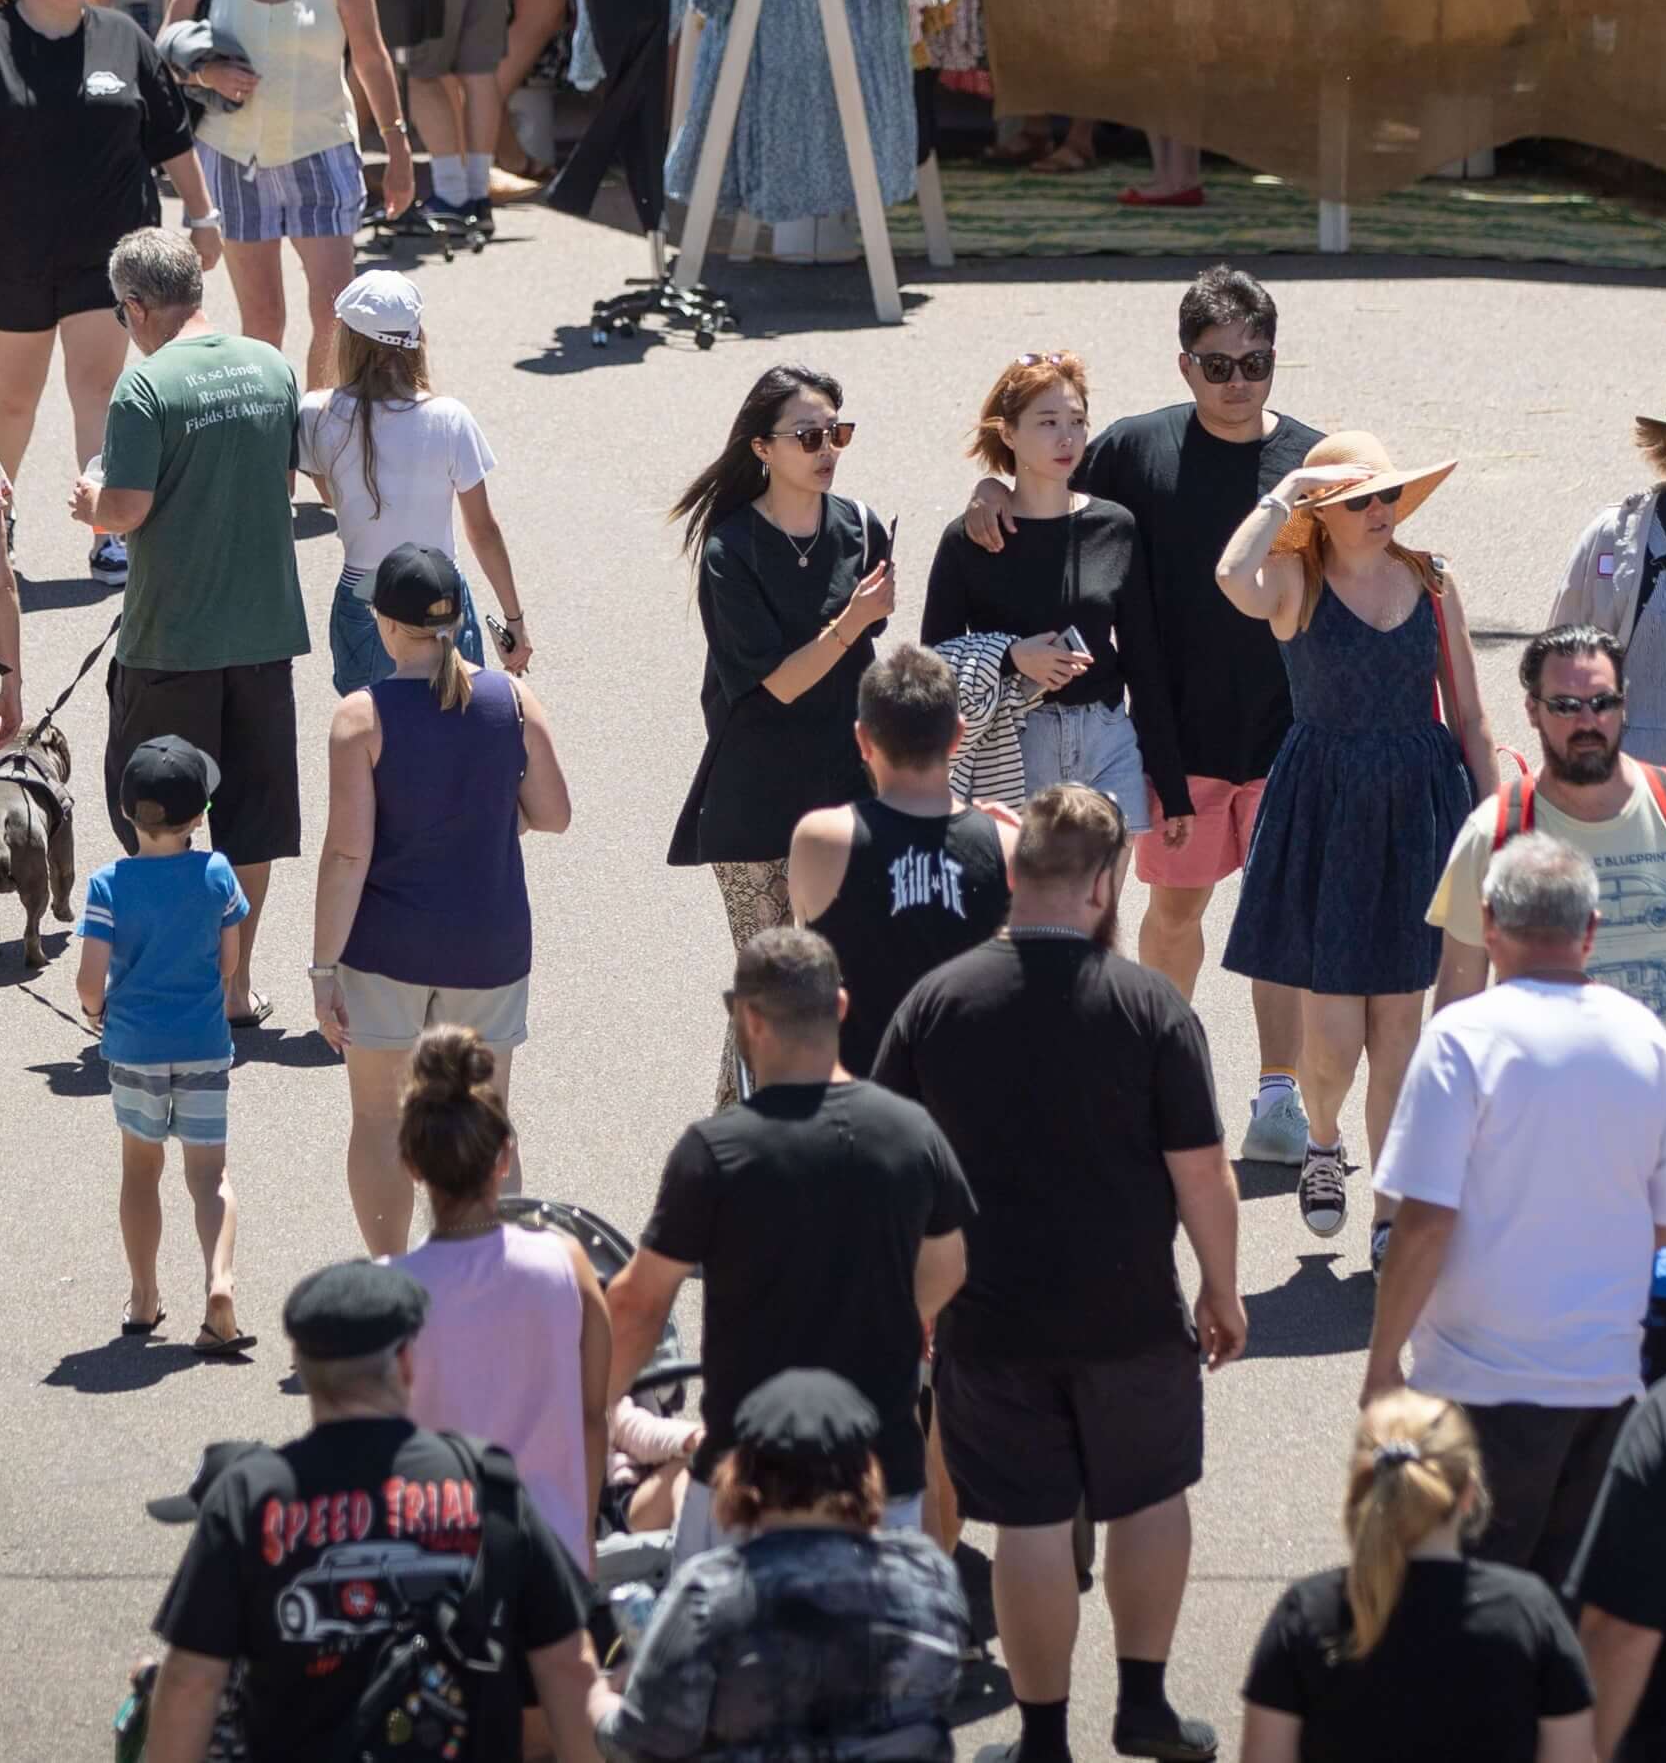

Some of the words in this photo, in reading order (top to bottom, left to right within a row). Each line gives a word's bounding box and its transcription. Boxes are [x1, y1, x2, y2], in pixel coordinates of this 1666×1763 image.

[185, 372, 207, 388] It's
[208, 367, 223, 381] so
[223, 363, 263, 378] lonely
[198, 382, 240, 405] Round
[241, 381, 265, 397] the
[185, 409, 224, 436] Fields
[261, 1488, 374, 1566] SPEED
[383, 1476, 479, 1539] TRIAL
